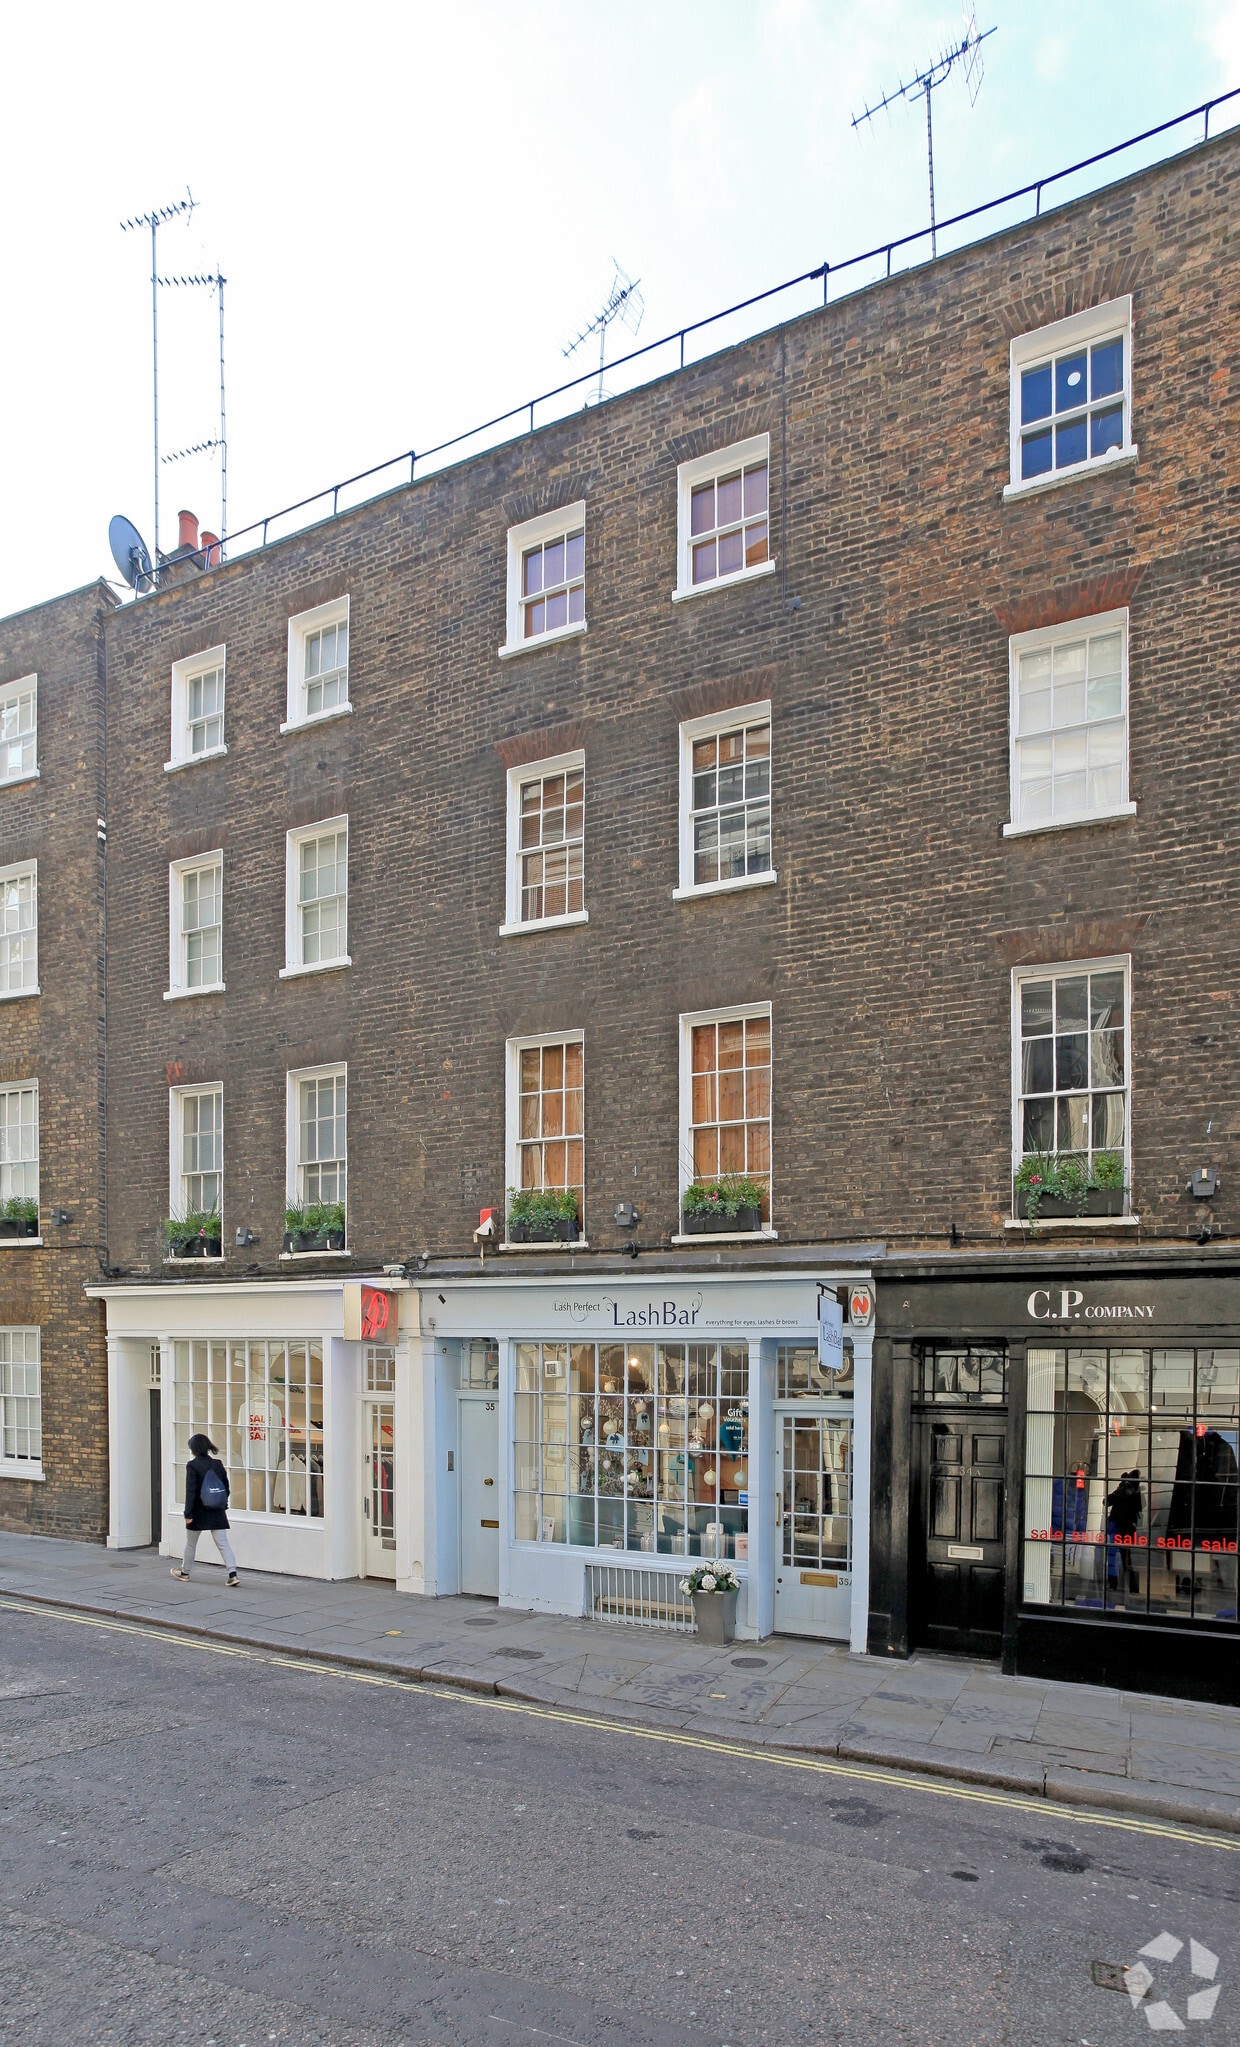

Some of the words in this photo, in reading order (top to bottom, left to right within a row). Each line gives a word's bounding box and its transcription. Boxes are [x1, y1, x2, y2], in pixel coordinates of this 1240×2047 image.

[553, 1302, 571, 1312] Lash
[573, 1302, 600, 1312] Perfect
[1027, 1290, 1083, 1319] C.P.
[1084, 1305, 1155, 1318] COMPANY
[612, 1301, 701, 1326] LashBar
[485, 1402, 495, 1411] 35
[727, 1408, 742, 1417] Gift
[1030, 1526, 1064, 1541] sale
[1071, 1529, 1105, 1544] sale
[1113, 1531, 1148, 1547] sale
[1156, 1534, 1192, 1550] sale
[1201, 1537, 1237, 1553] sale
